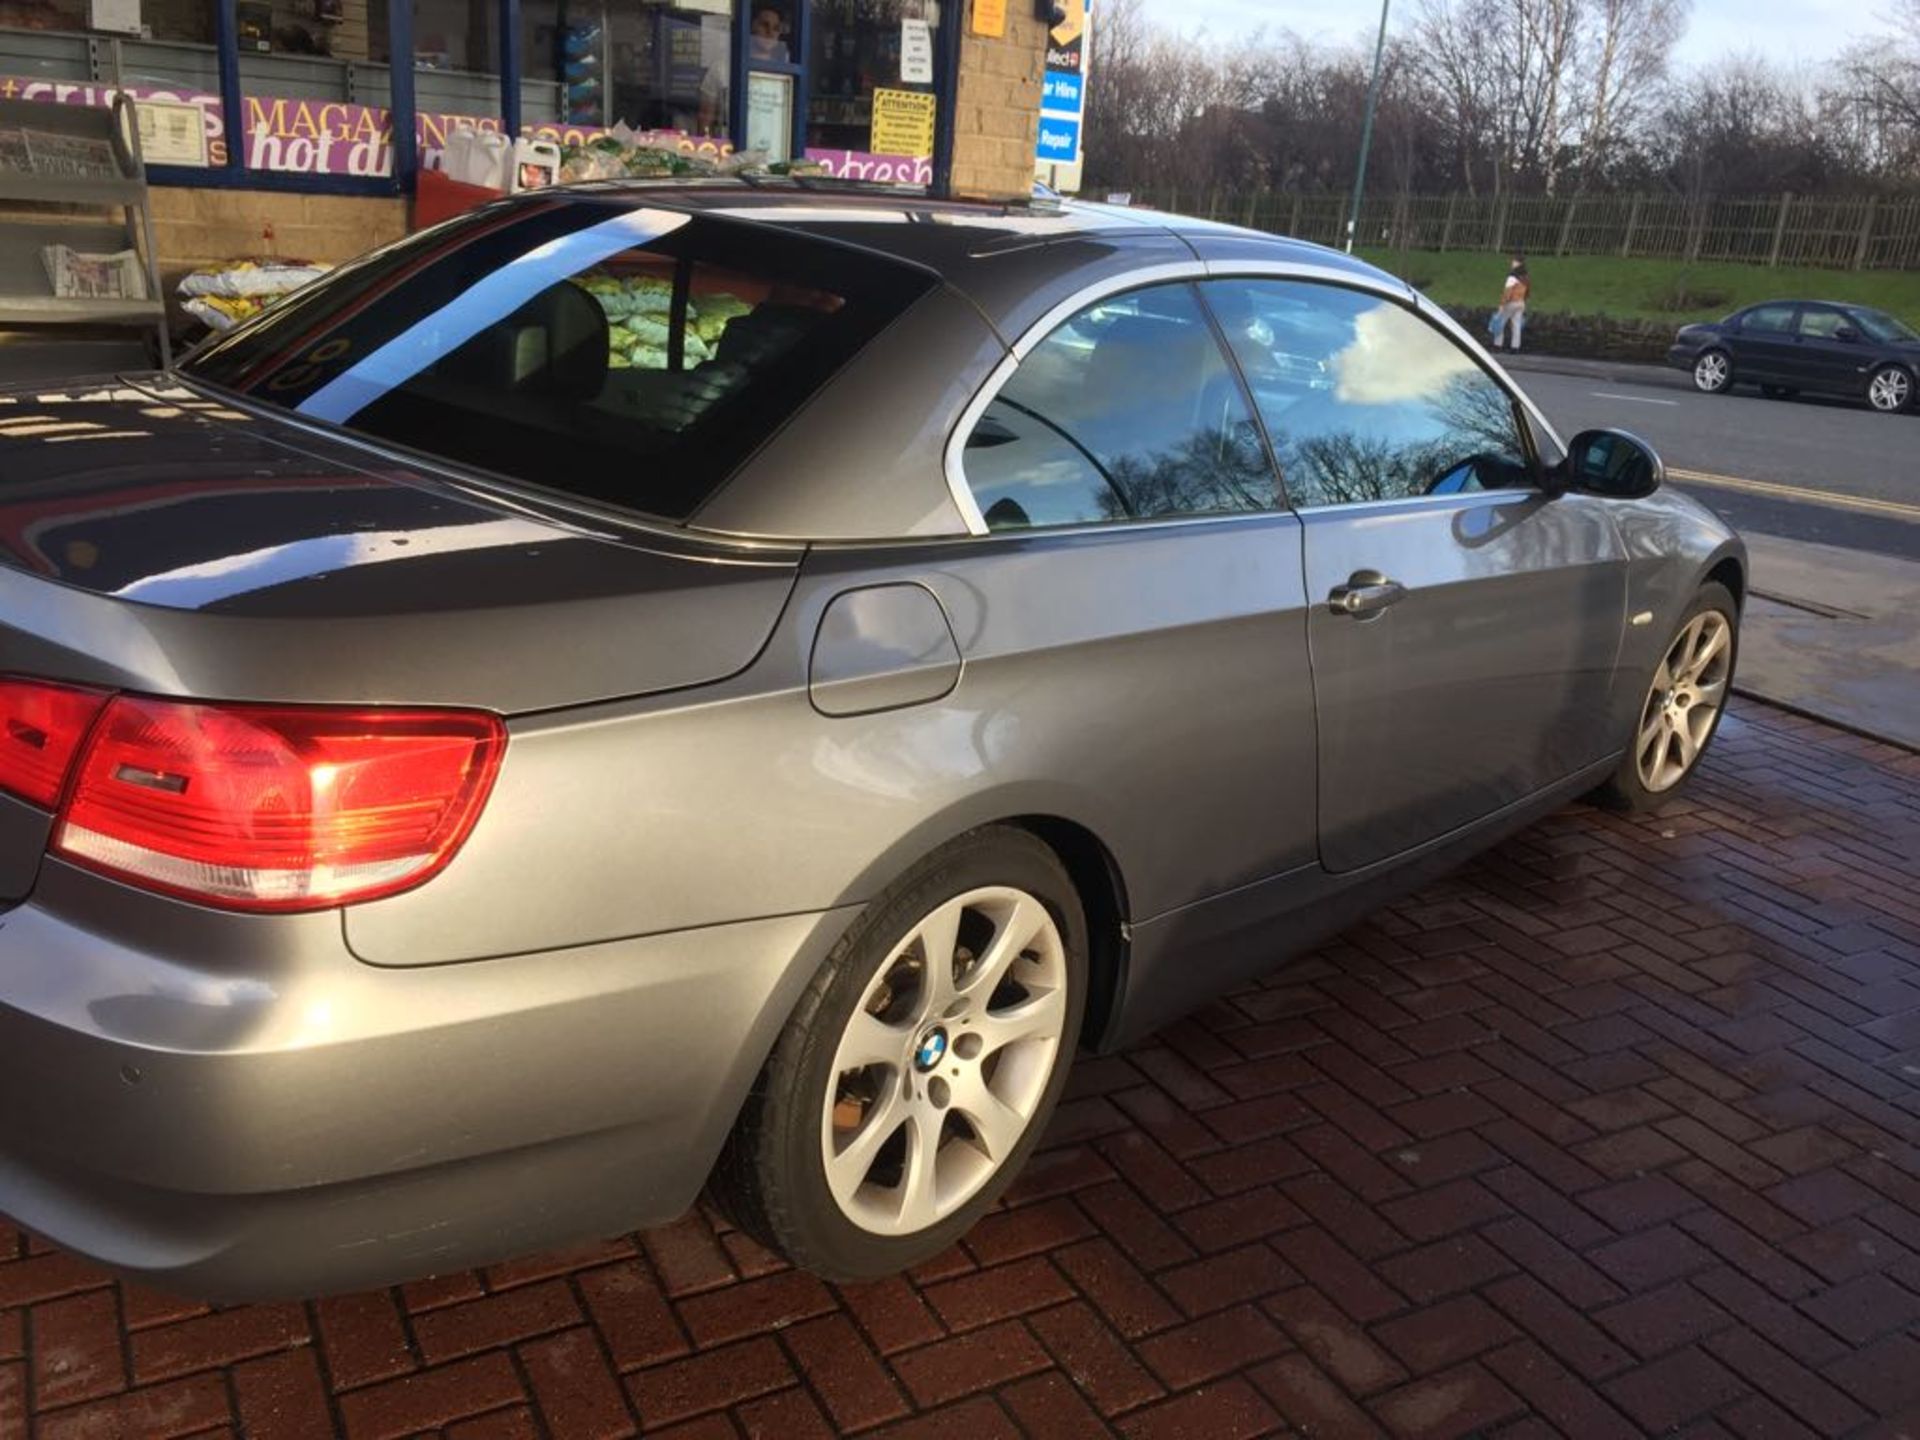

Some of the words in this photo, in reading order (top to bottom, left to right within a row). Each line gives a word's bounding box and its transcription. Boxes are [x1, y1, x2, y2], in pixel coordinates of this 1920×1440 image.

[1043, 82, 1054, 96] ar
[1055, 80, 1078, 99] Hire
[882, 98, 929, 111] ATTENTION
[251, 121, 333, 173] hot
[1041, 129, 1072, 151] Repair
